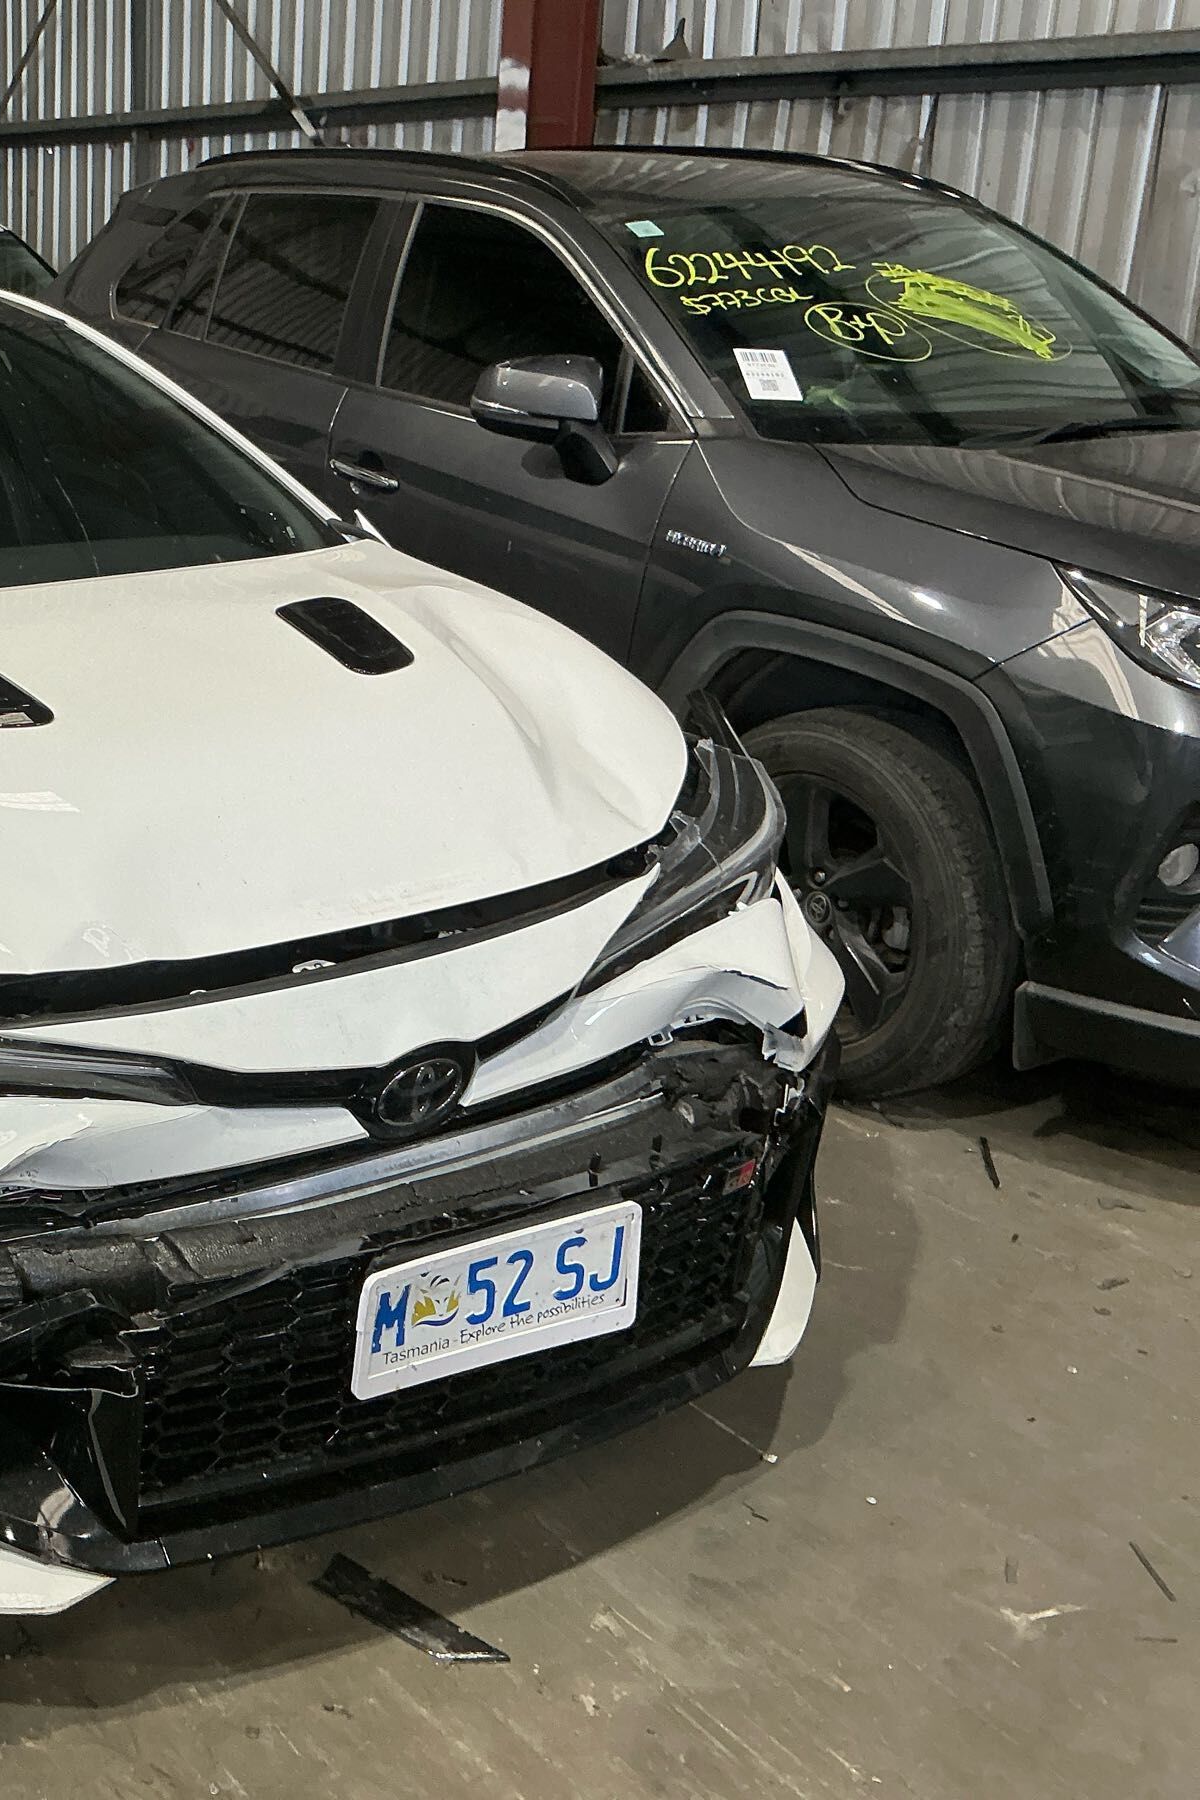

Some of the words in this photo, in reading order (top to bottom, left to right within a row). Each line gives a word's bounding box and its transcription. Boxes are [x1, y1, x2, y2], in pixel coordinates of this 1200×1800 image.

[371, 1283, 412, 1354] M
[466, 1249, 535, 1326] 52
[553, 1226, 625, 1302] SJ
[383, 1337, 450, 1365] Tasmania
[460, 1322, 506, 1344] Explore
[509, 1312, 535, 1329] the
[537, 1293, 605, 1323] possibilities
